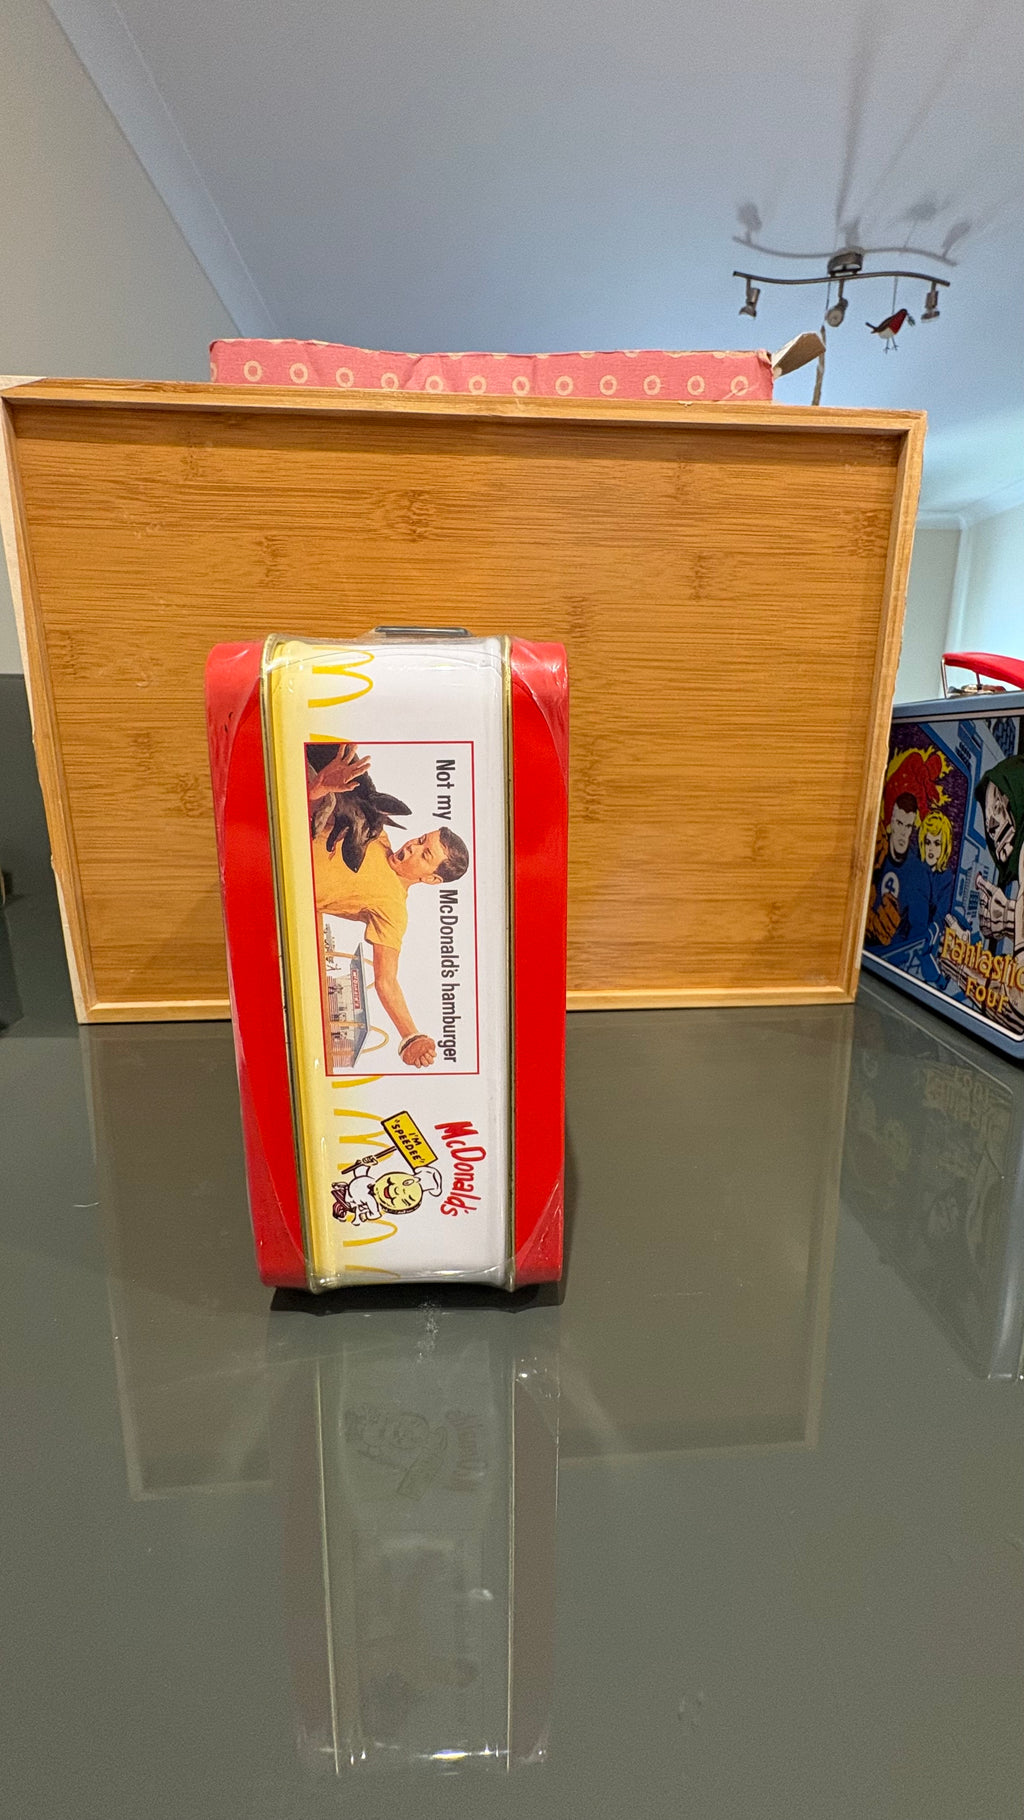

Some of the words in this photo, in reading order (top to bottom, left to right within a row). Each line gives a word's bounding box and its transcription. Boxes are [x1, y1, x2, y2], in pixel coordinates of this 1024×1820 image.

[436, 759, 456, 789] Not
[432, 795, 451, 820] my
[439, 889, 460, 978] McDonald's
[437, 983, 462, 1063] hamburger
[408, 1132, 422, 1146] I'M
[434, 1121, 487, 1217] McDonald's
